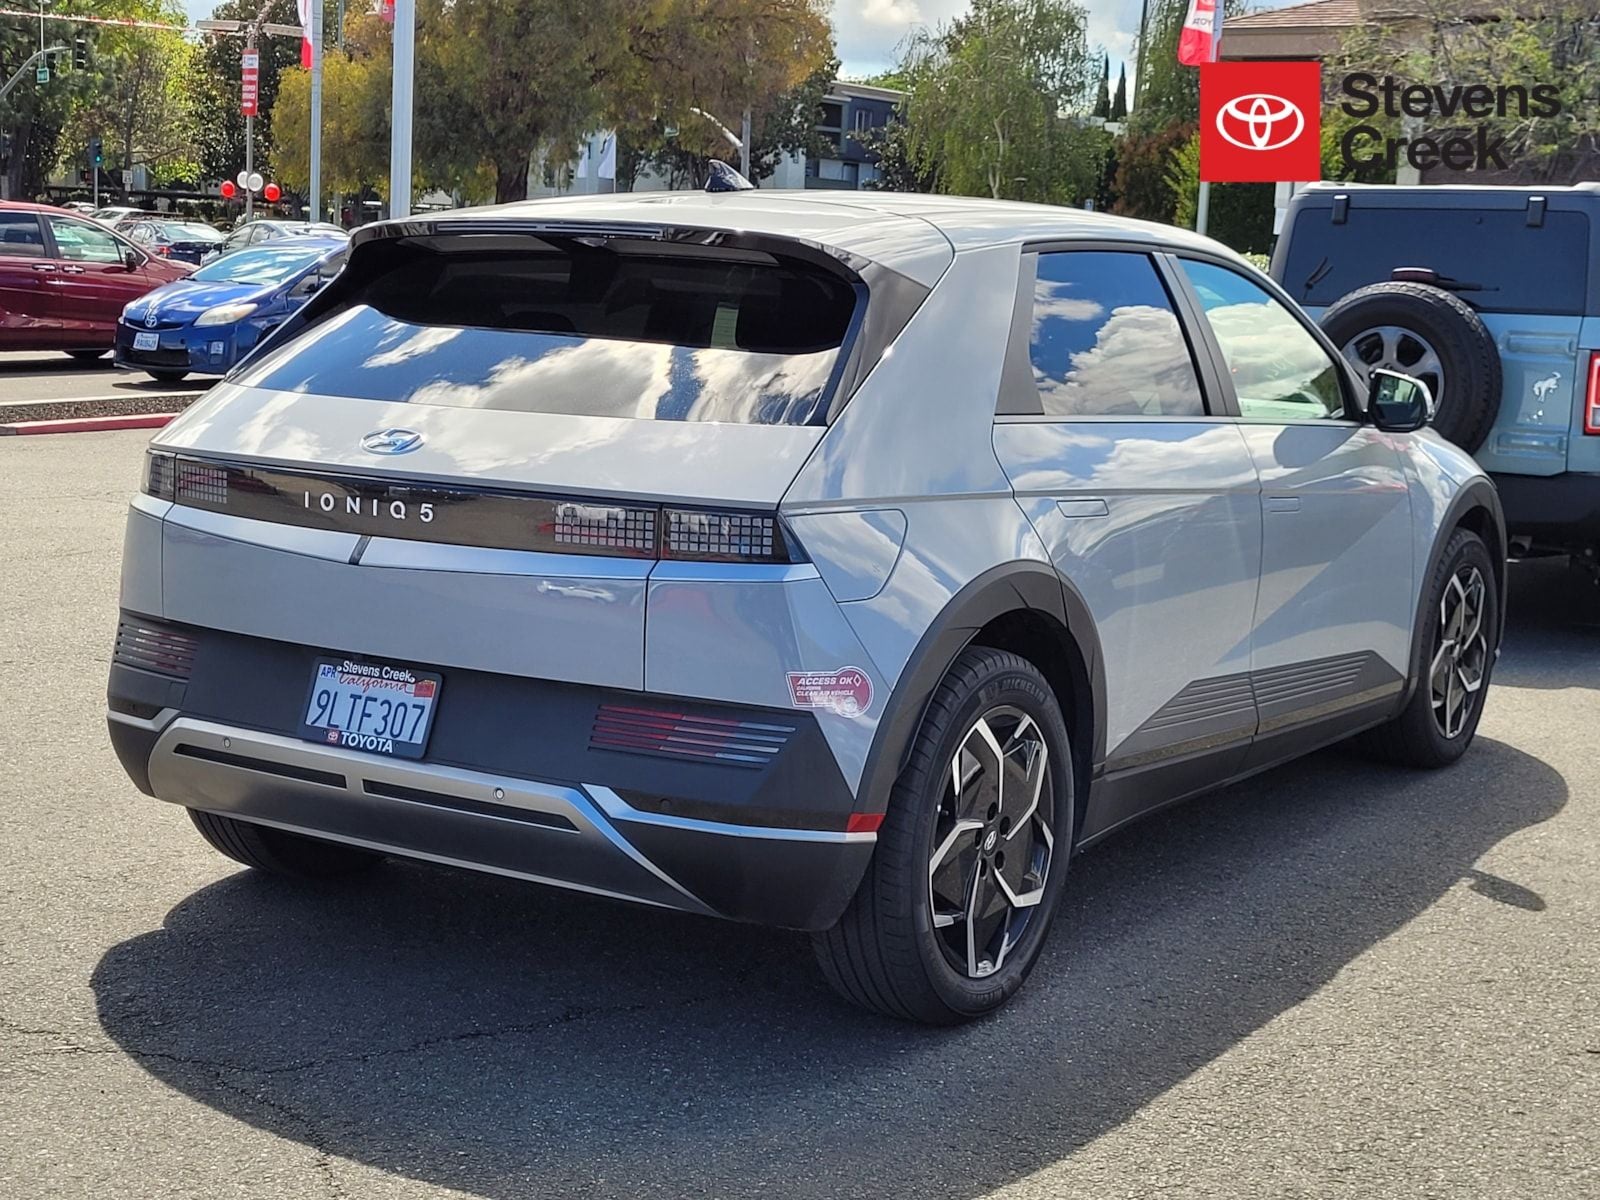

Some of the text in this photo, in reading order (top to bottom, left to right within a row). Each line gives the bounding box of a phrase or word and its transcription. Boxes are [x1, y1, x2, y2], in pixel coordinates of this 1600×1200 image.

[304, 491, 434, 523] IONIQ 5
[320, 665, 336, 679] APR
[342, 660, 411, 682] Stevens Creek
[338, 673, 409, 693] California
[1001, 678, 1046, 703] MICHELIN
[311, 689, 426, 742] 9LTF307
[341, 731, 394, 754] TOYOTA
